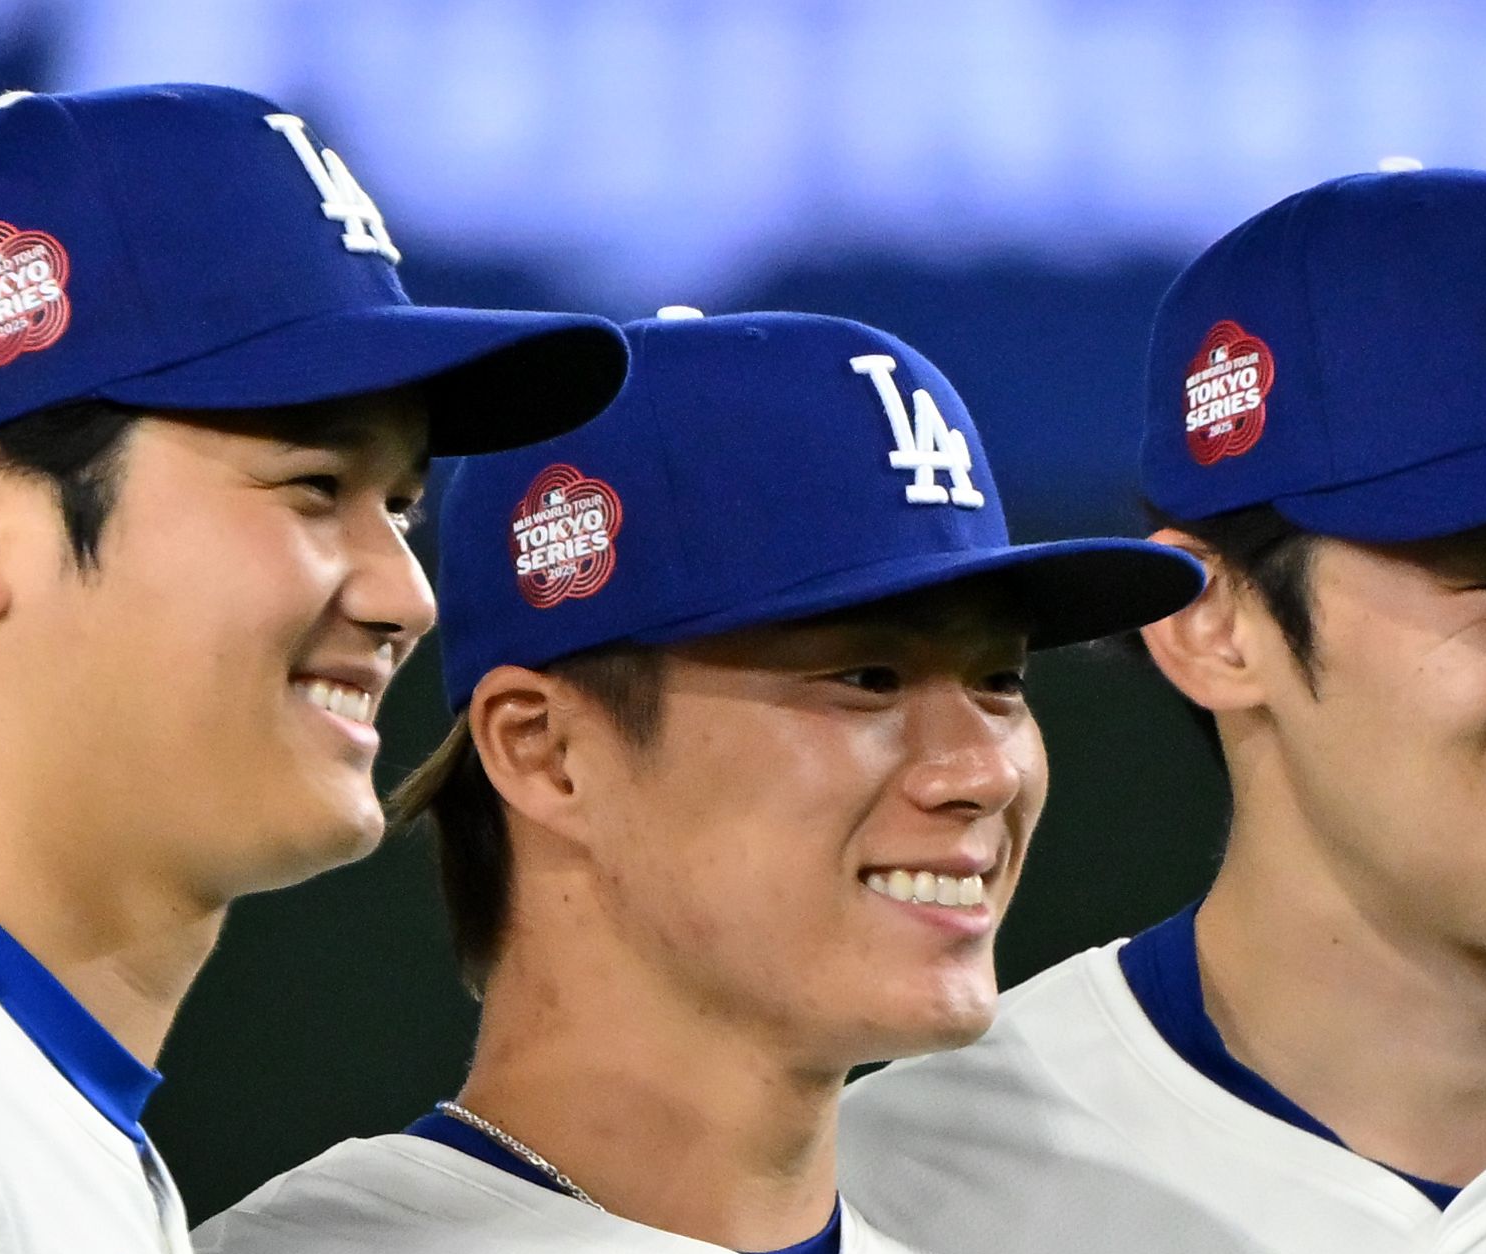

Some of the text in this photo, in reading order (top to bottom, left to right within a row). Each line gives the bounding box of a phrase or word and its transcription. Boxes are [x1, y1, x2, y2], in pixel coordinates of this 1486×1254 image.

[263, 113, 402, 265] LA
[12, 245, 49, 266] TOUR
[1185, 387, 1261, 432] SERIES
[1186, 367, 1258, 409] TOKYO
[849, 354, 985, 508] LA
[513, 494, 604, 533] MLB WORLD TOUR
[516, 509, 604, 553] TOKYO
[516, 530, 610, 575] SERIES
[548, 563, 577, 580] 2025
